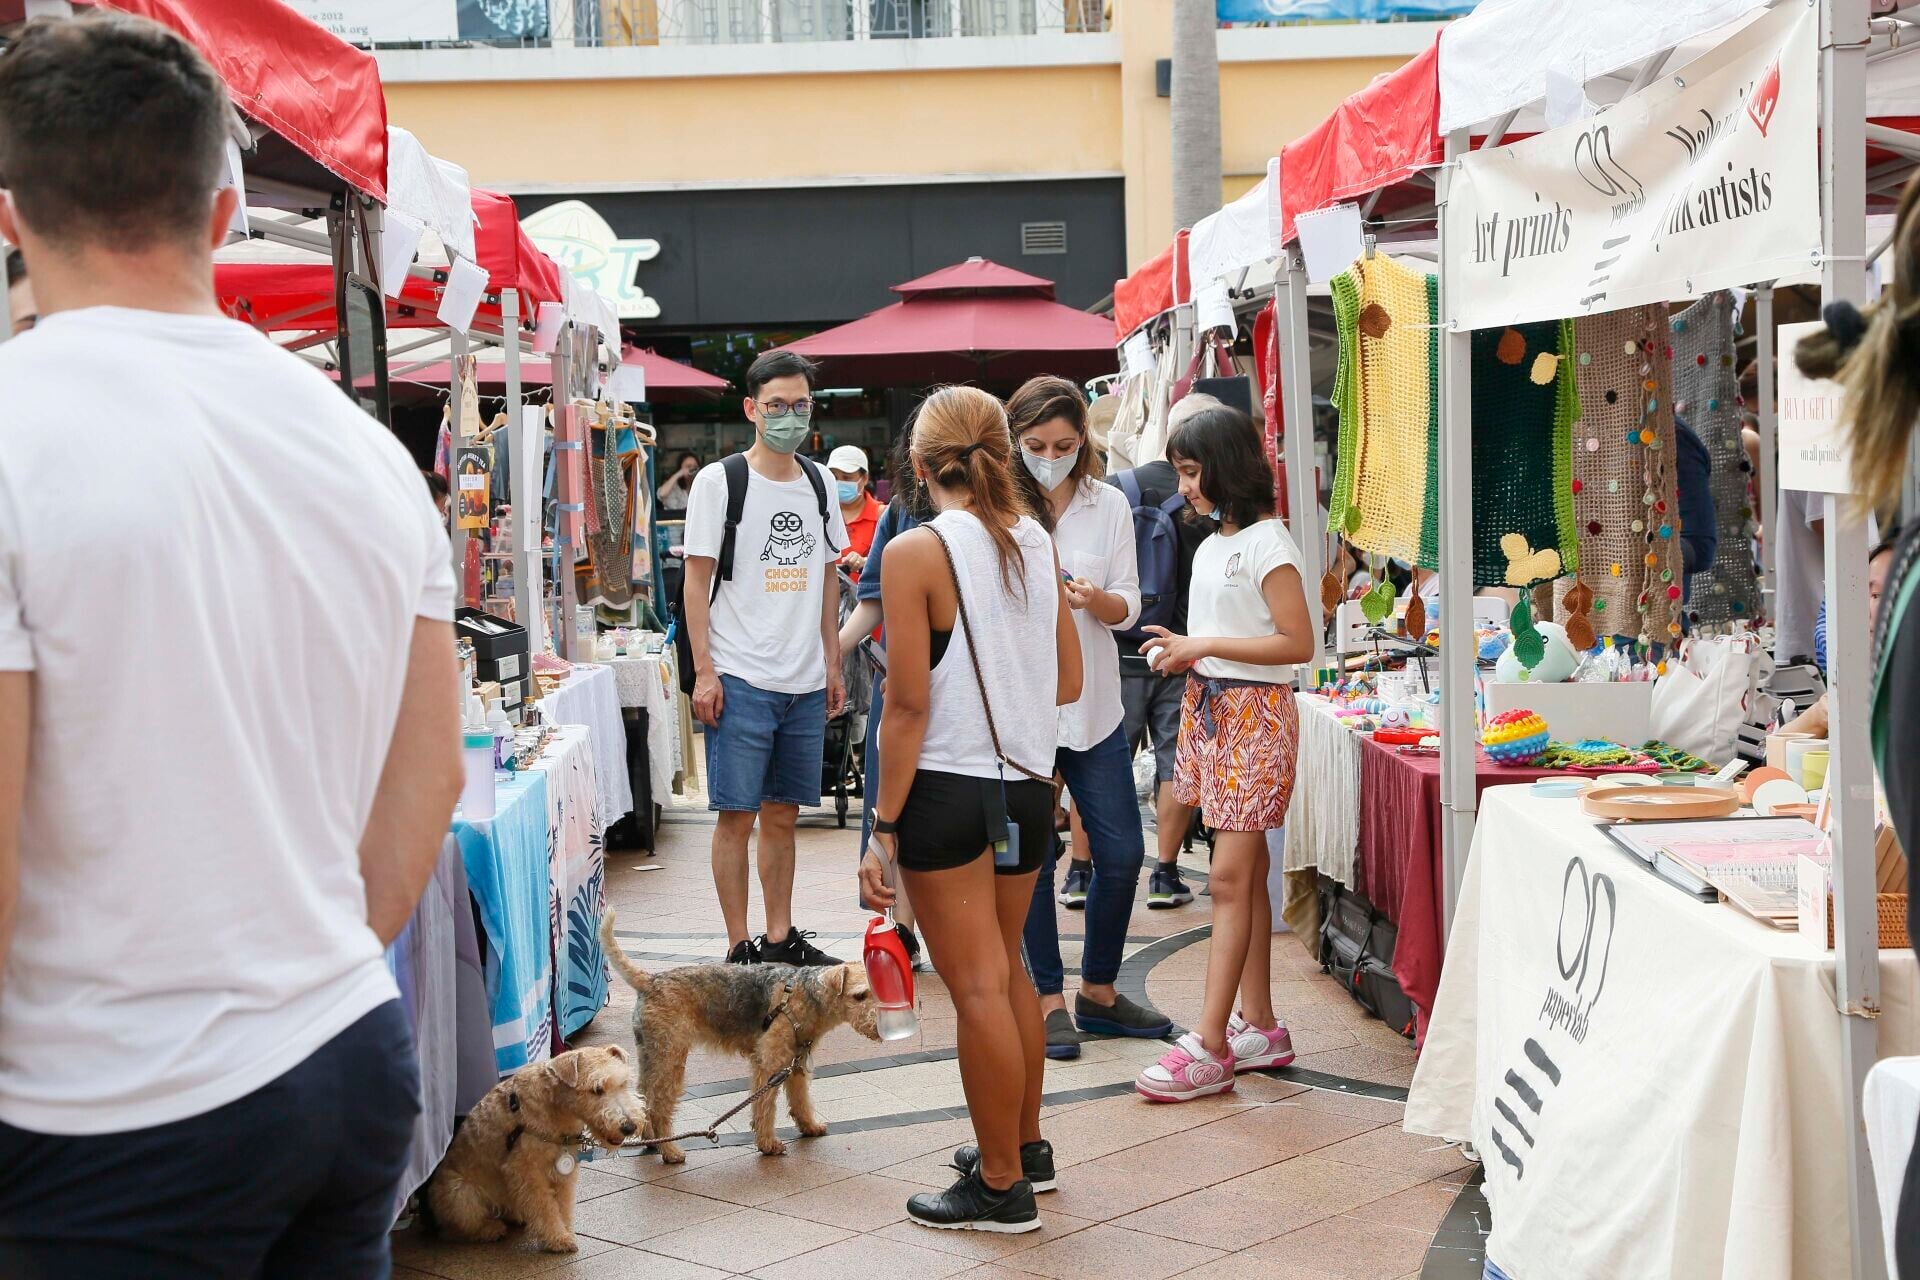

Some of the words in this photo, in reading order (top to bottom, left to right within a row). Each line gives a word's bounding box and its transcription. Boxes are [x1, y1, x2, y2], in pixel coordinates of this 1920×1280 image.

[321, 12, 344, 21] 2012
[1698, 160, 1772, 227] artists
[1469, 211, 1500, 264] Art
[1500, 191, 1573, 277] prints
[1784, 398, 1799, 420] BUY
[1809, 444, 1817, 461] all
[764, 567, 808, 579] CHOOSE
